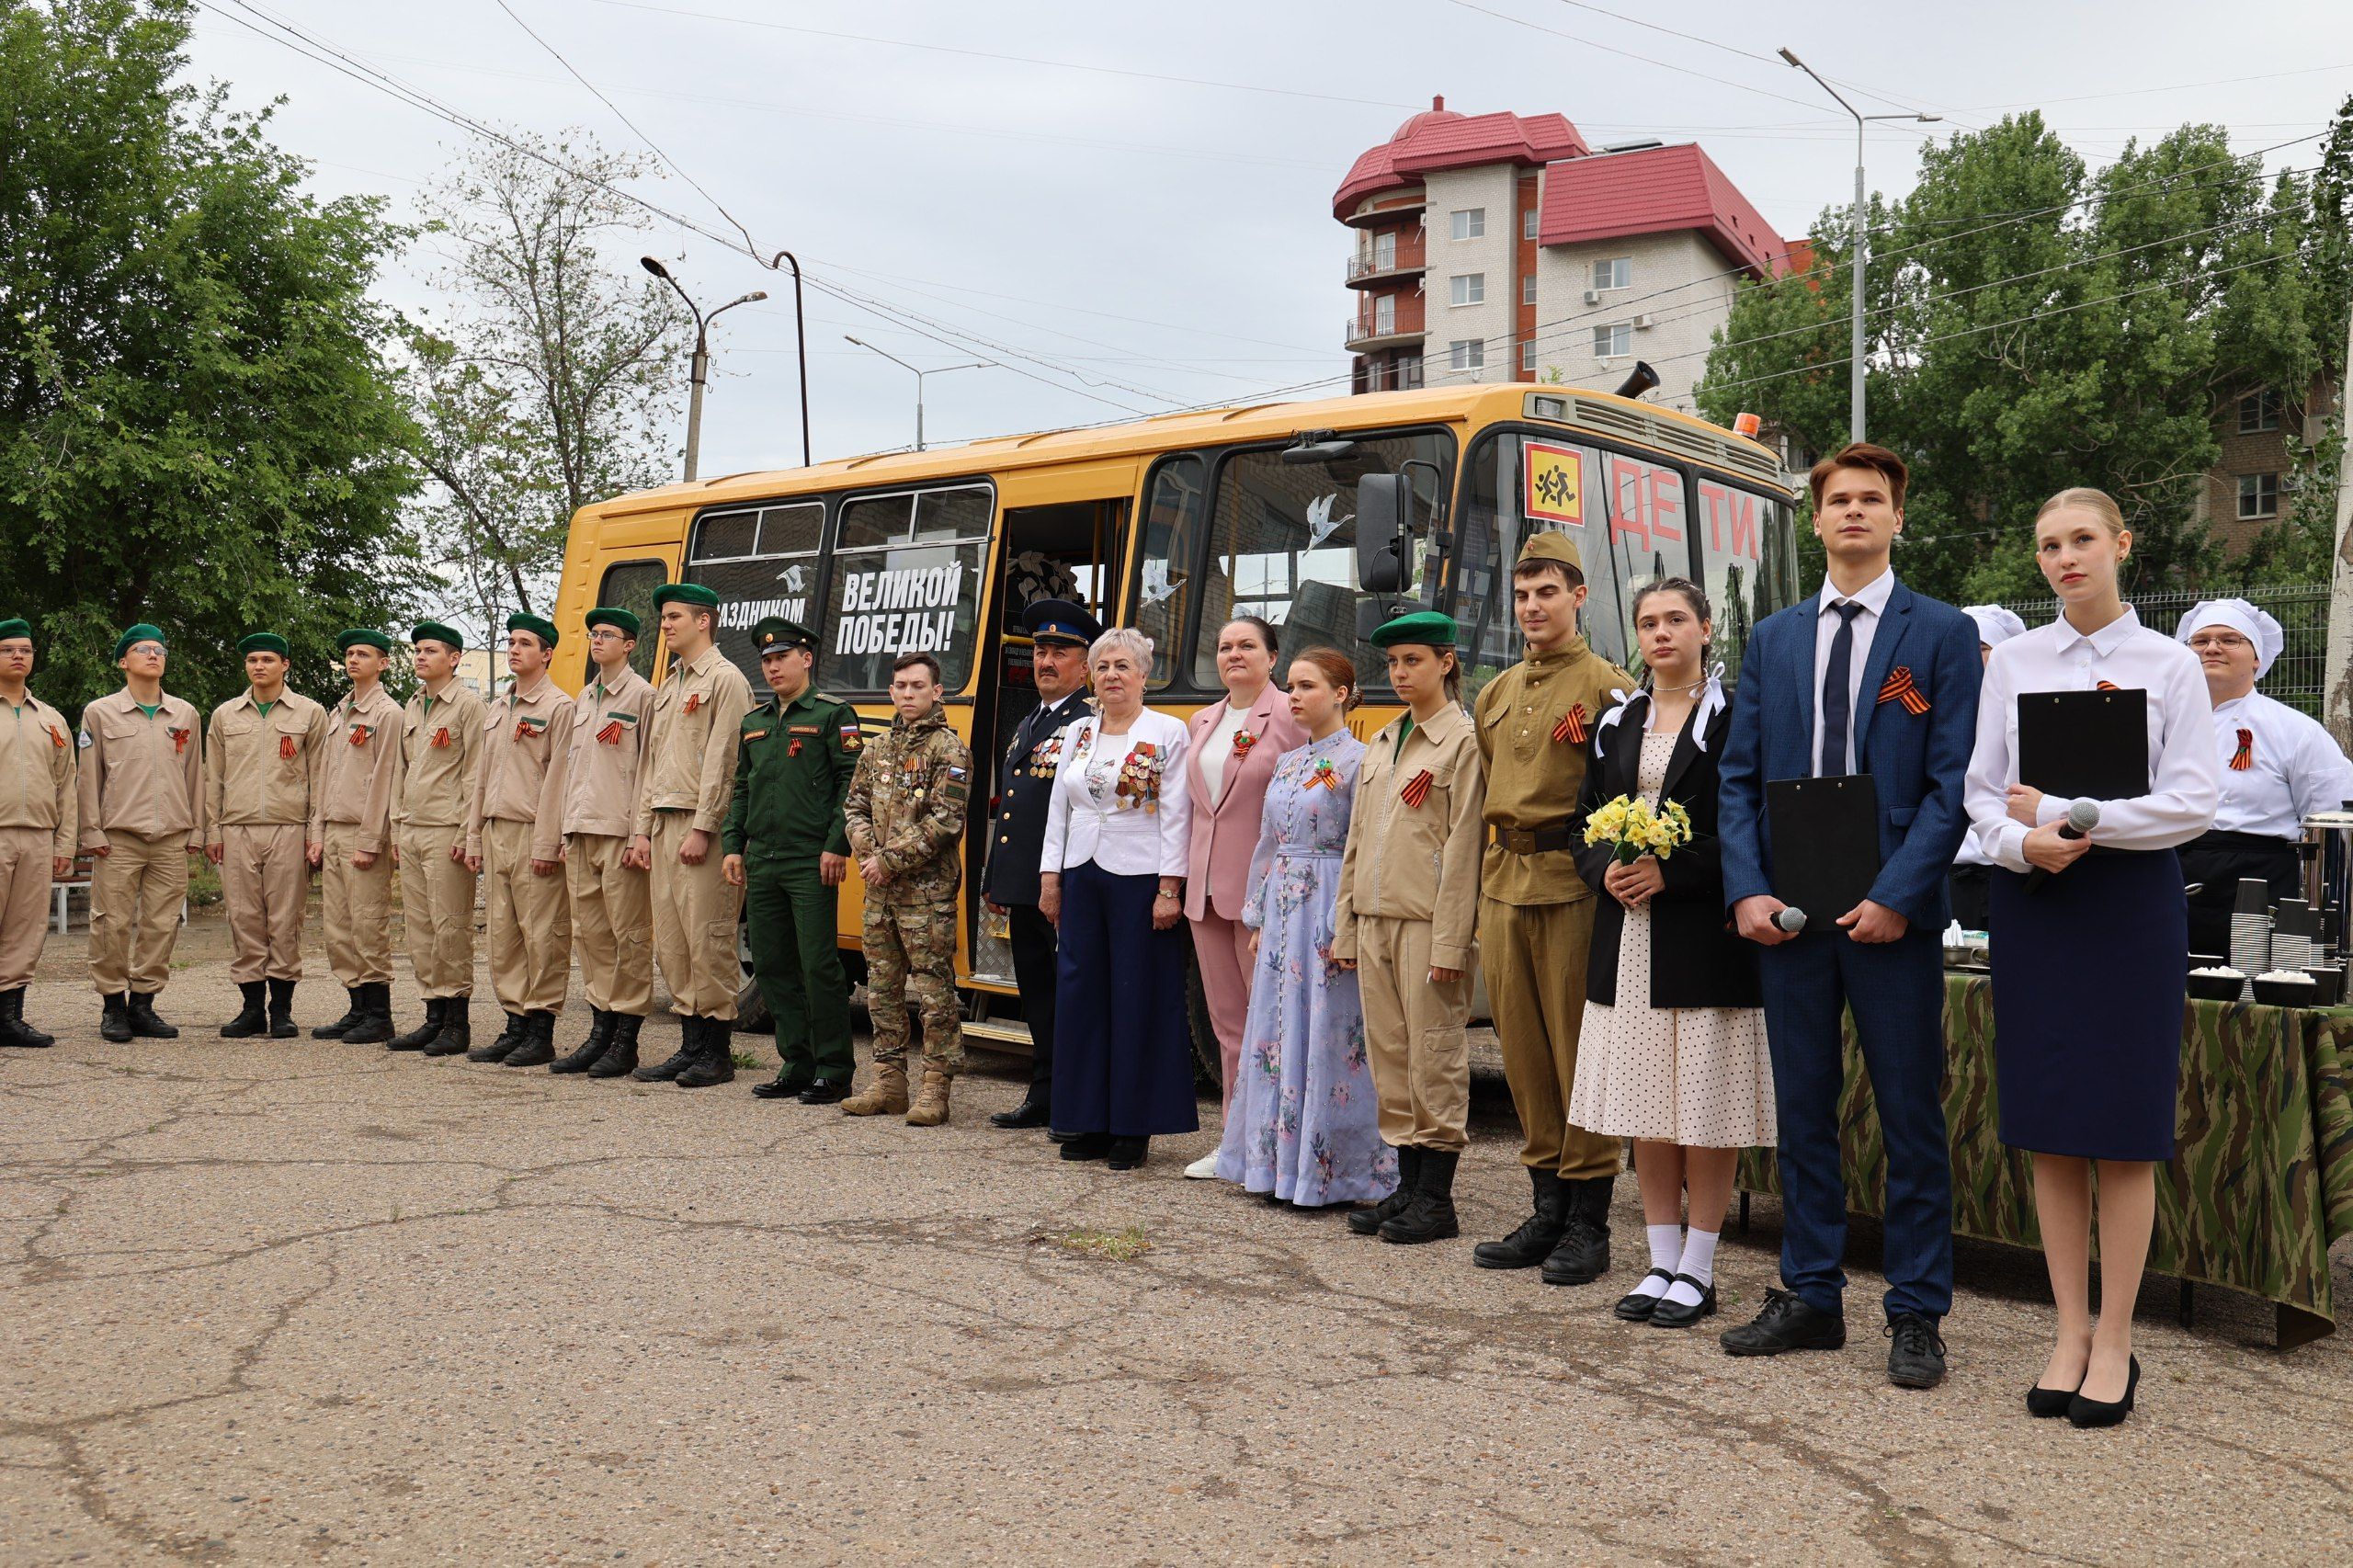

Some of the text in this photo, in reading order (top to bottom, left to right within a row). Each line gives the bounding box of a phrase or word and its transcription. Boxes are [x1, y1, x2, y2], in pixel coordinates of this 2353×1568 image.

[842, 561, 962, 612] ВЕЛИКОЙ
[717, 598, 806, 631] АЗДНИКОМ
[835, 611, 955, 658] ПОБЕДЫ!
